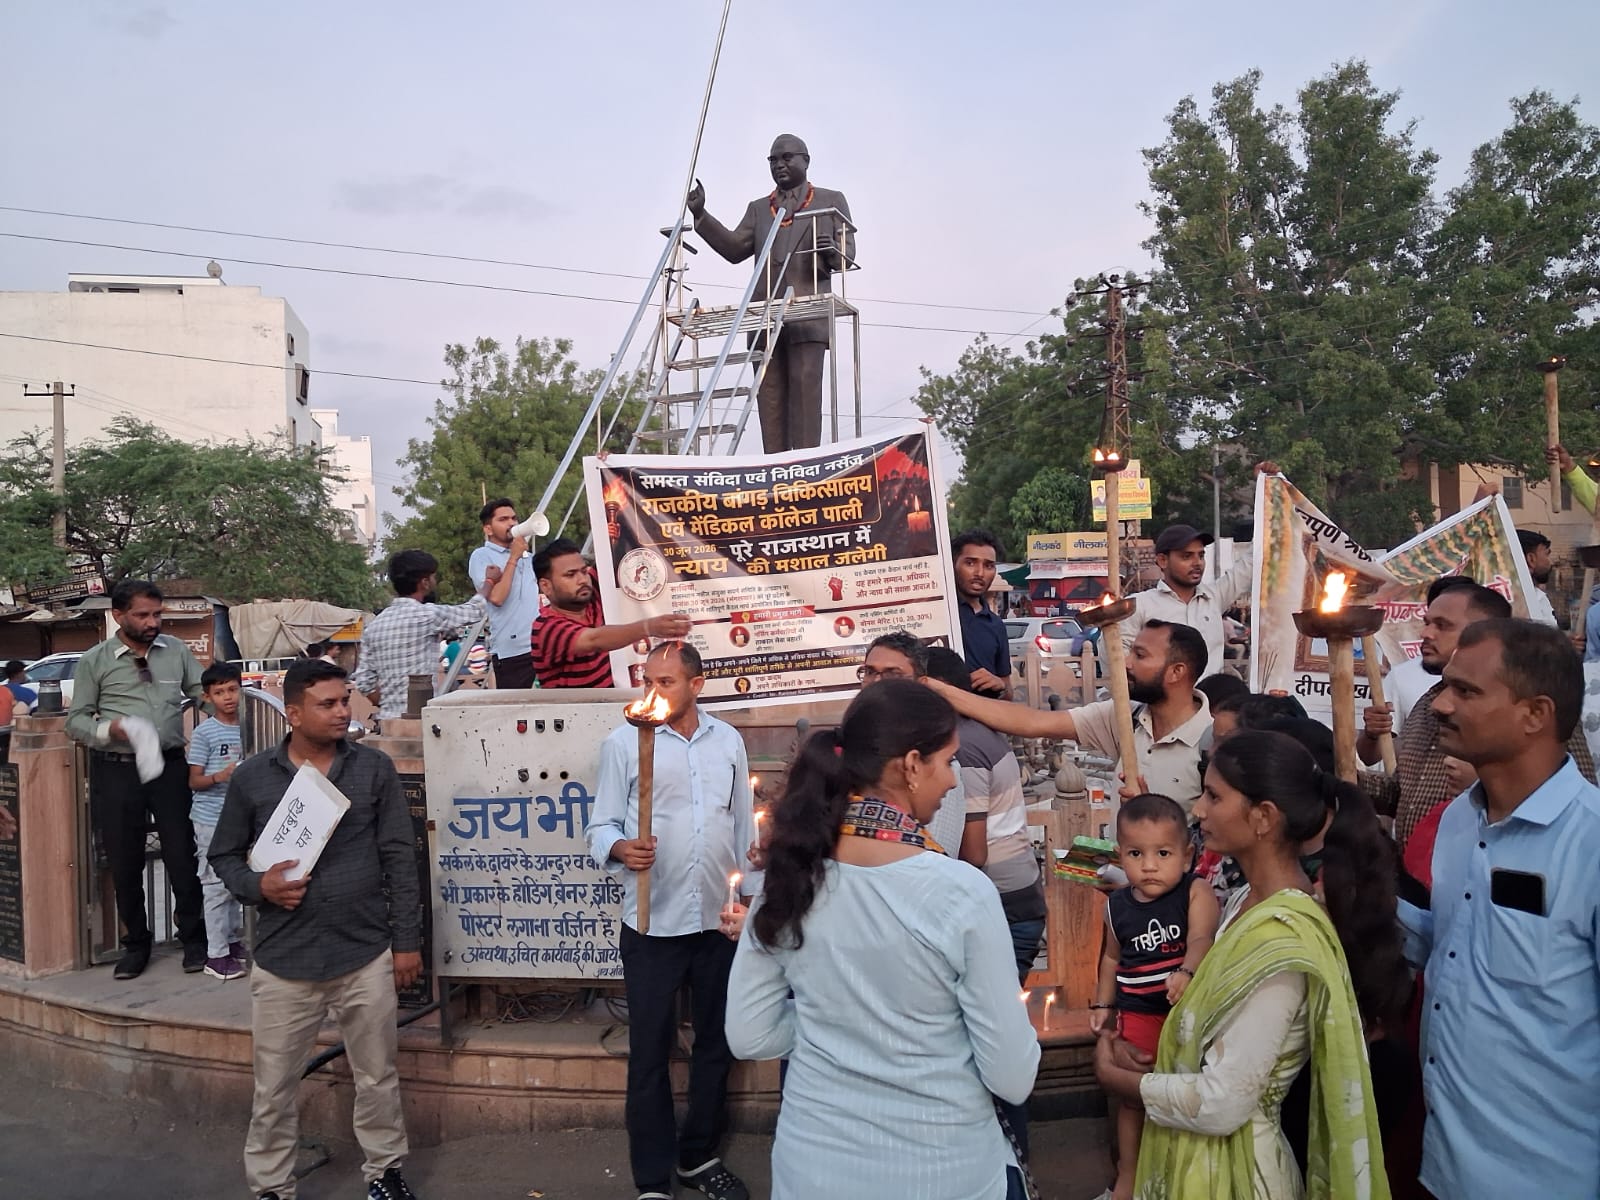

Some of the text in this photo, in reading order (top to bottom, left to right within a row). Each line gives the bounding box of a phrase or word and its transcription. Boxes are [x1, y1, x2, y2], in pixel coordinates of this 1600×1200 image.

[640, 474, 688, 489] समस्त
[694, 470, 741, 487] संविदा
[745, 471, 766, 485] एवं
[770, 462, 820, 480] निविदा
[641, 474, 873, 516] राजकीय बांगड़ चिकित्सालय
[660, 521, 685, 539] एवं
[760, 504, 818, 529] कॉलेज
[822, 497, 863, 522] पाली
[663, 547, 675, 557] 30
[675, 546, 692, 558] जून
[694, 544, 717, 554] 2026
[729, 525, 871, 562] पूरे राजस्थान में
[1033, 540, 1061, 550] नीलकंठ
[672, 543, 888, 576] न्याय की मशाल जलेगी
[856, 590, 867, 598] और
[885, 586, 893, 594] की
[867, 577, 881, 586] हमारे
[907, 572, 930, 581] अधिकार
[220, 743, 229, 756] B
[448, 781, 596, 839] जय भी
[438, 847, 474, 872] सर्कल
[471, 848, 487, 871] के
[488, 848, 519, 875] दायरे
[516, 848, 533, 871] के
[573, 854, 584, 870] व
[440, 879, 460, 905] भी
[461, 884, 497, 905] प्रकार
[494, 879, 511, 904] के
[592, 876, 625, 906] झंडि
[459, 909, 502, 937] पोस्टर
[507, 918, 549, 937] लगाना
[552, 911, 598, 938] वर्जित
[1131, 919, 1180, 951] TREND
[509, 941, 539, 967] उचित
[582, 941, 594, 962] की
[595, 941, 624, 964] जाये
